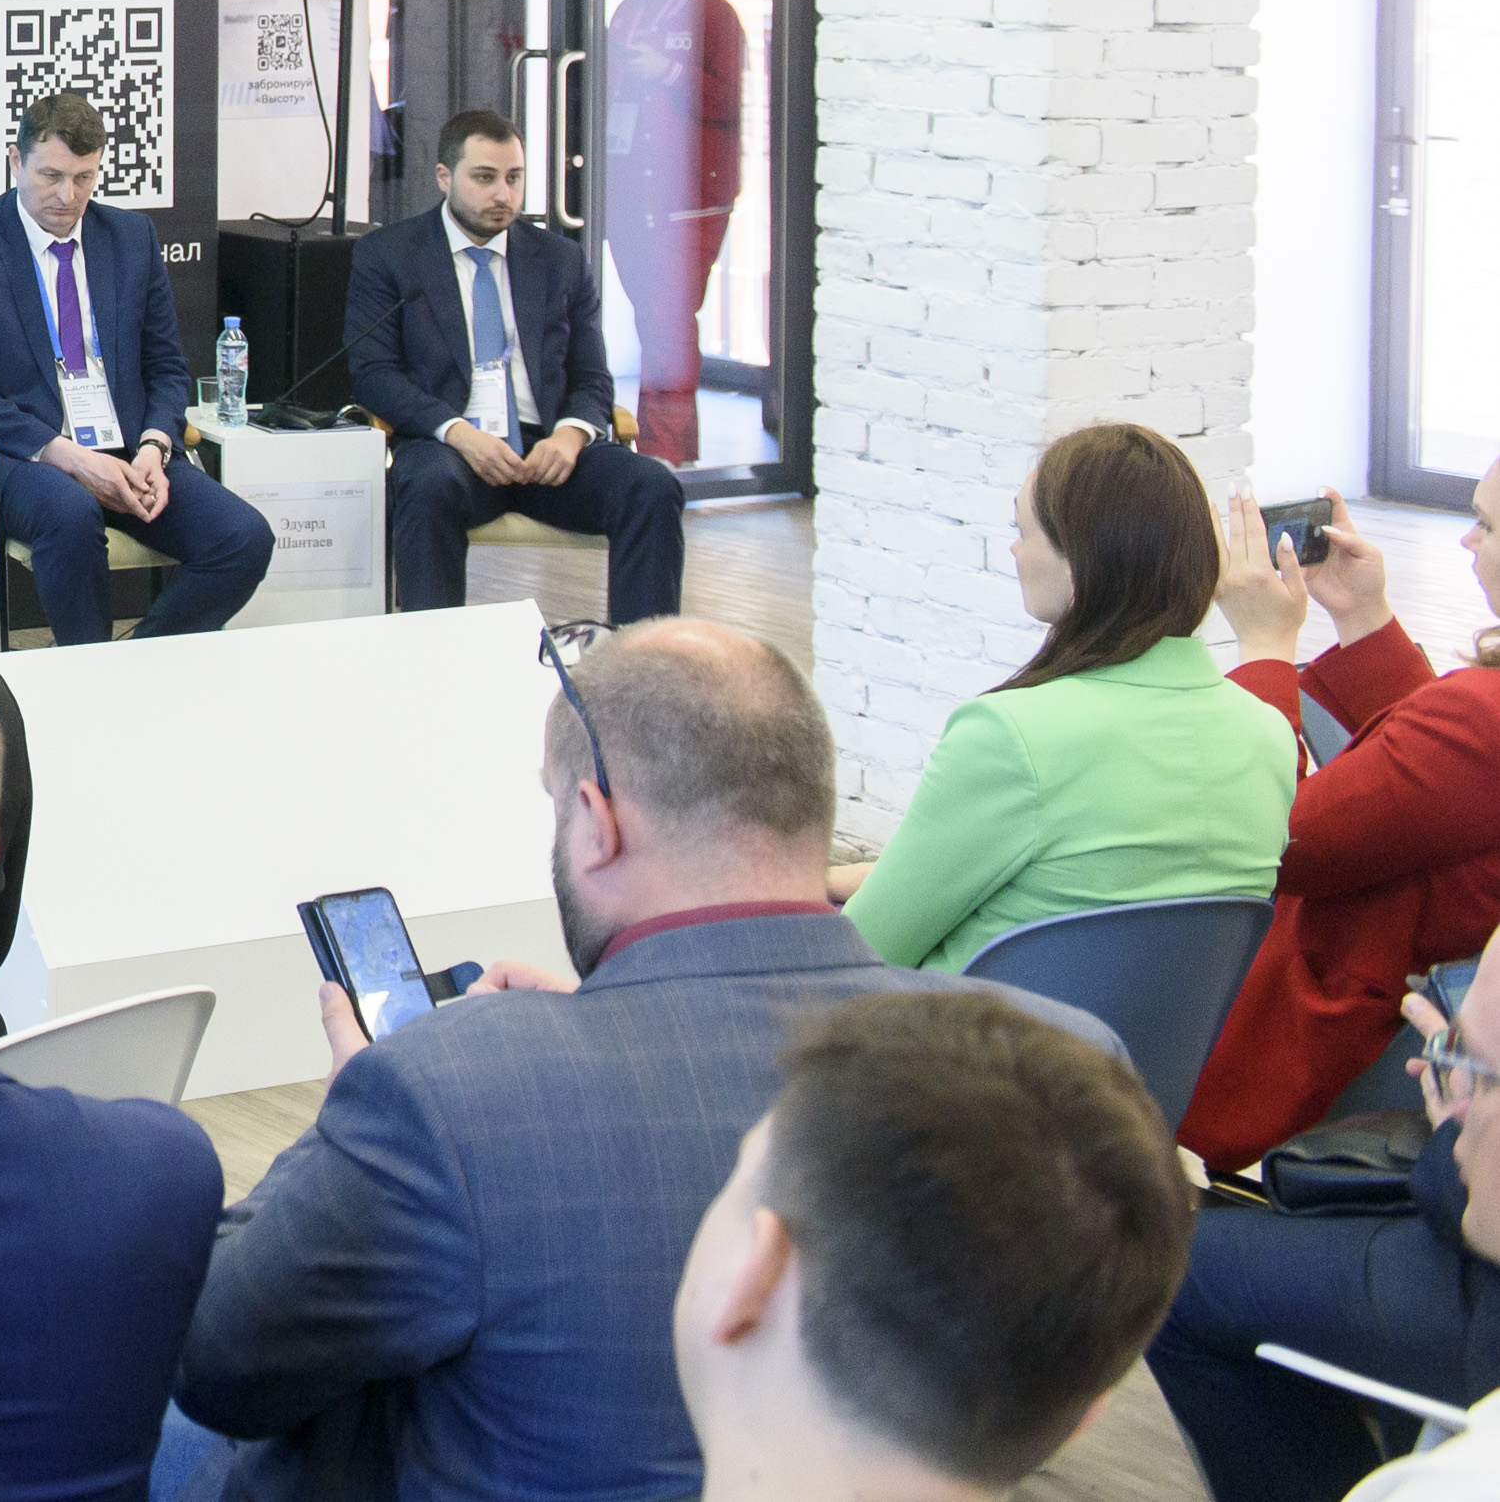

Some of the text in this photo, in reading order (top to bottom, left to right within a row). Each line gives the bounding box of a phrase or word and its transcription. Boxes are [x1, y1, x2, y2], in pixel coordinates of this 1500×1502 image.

[248, 77, 313, 91] забронируй
[255, 93, 306, 106] «Высоту»
[280, 518, 327, 533] Эдуард
[276, 536, 334, 550] Шантаев
